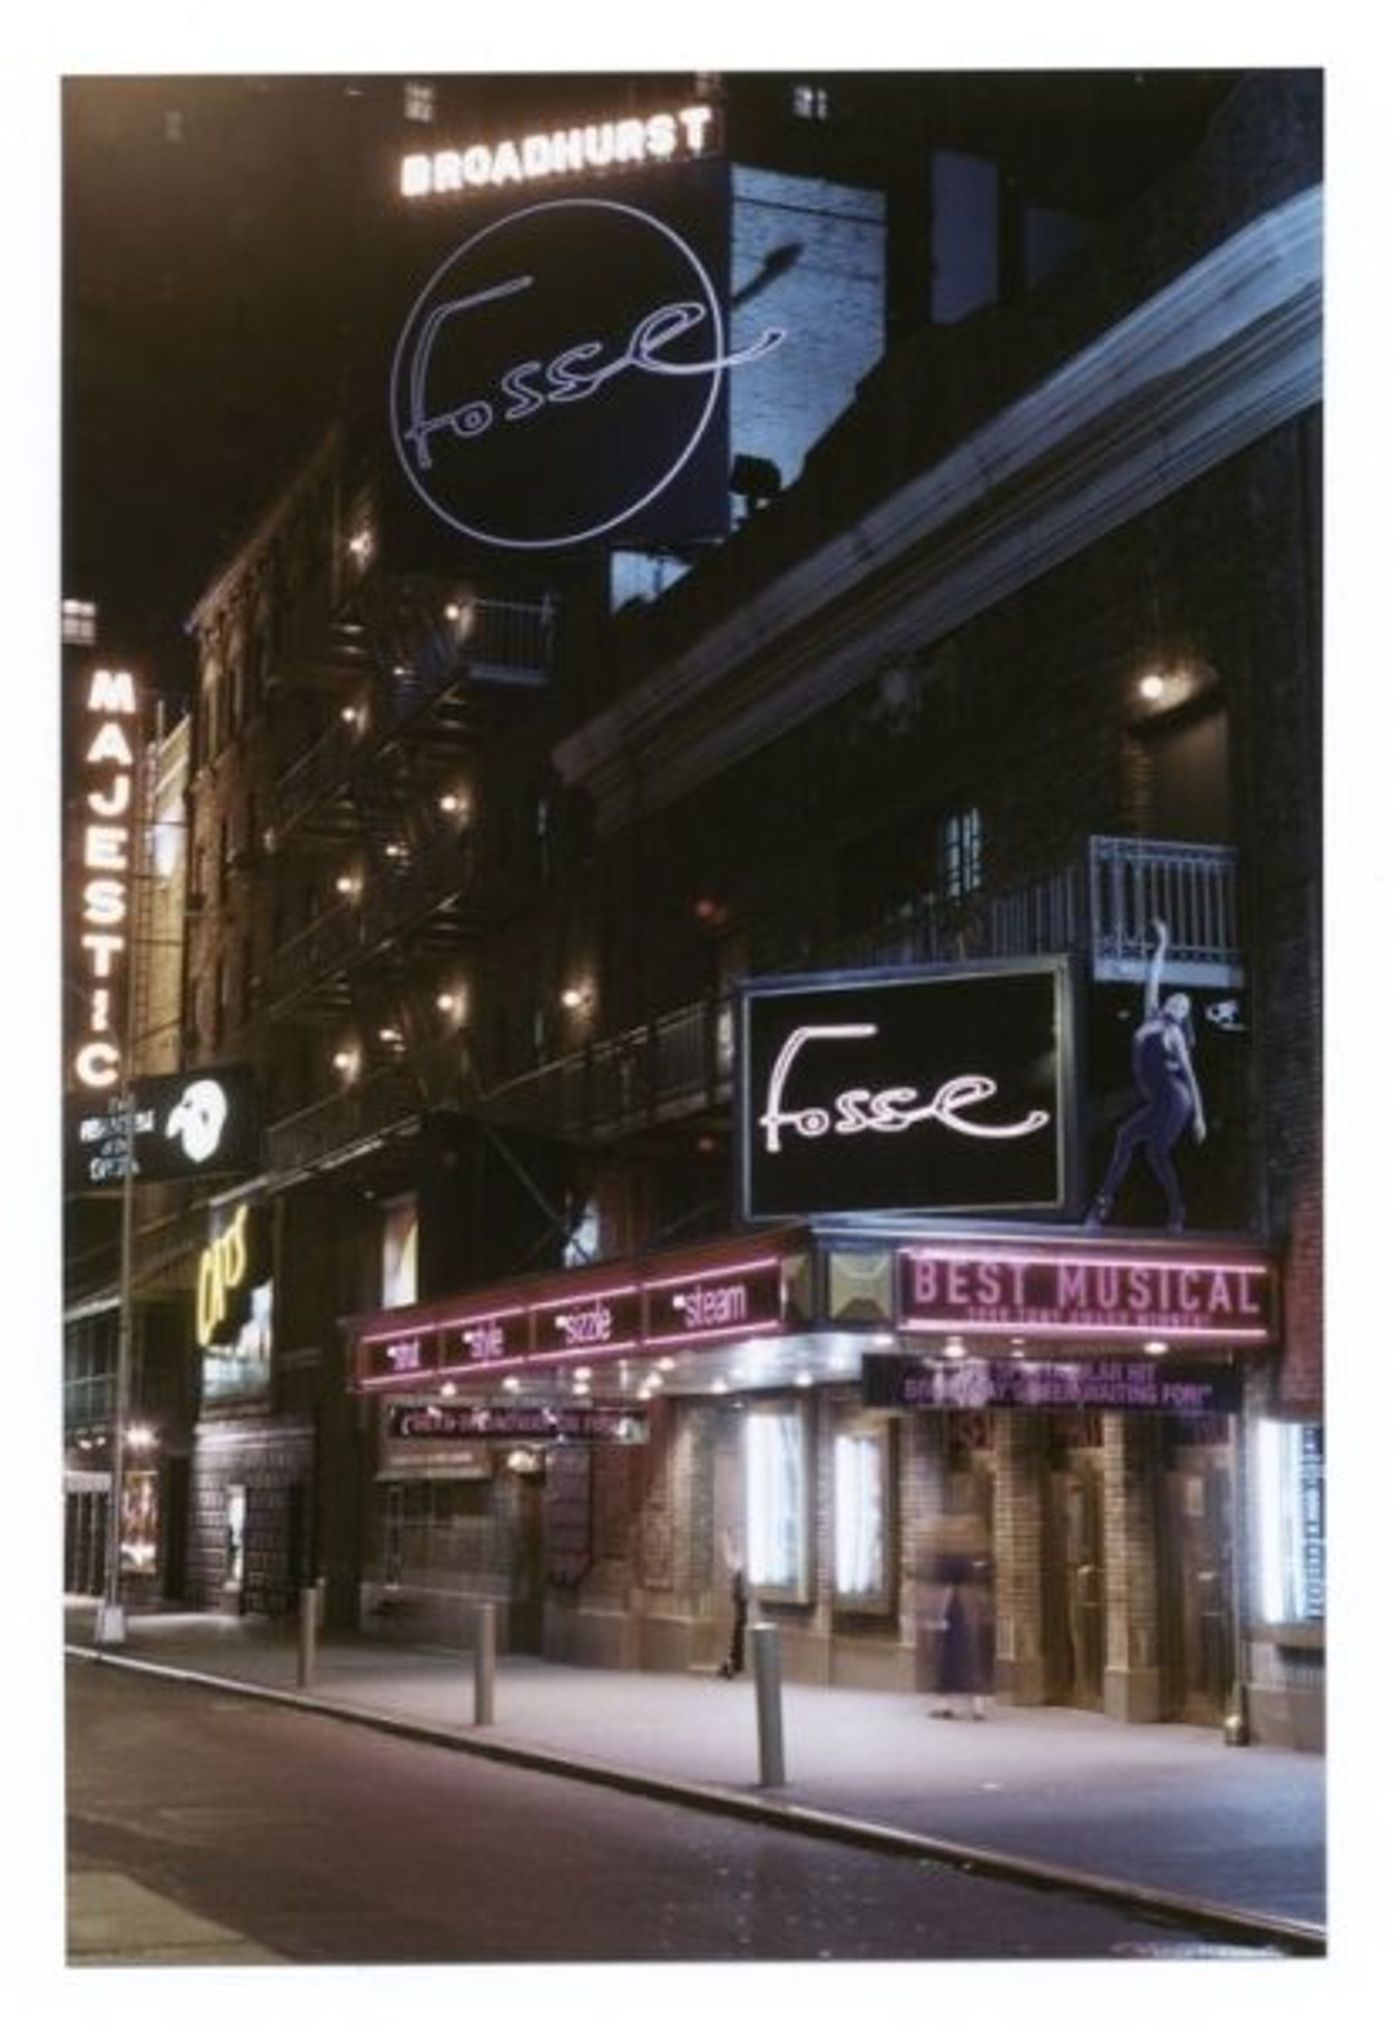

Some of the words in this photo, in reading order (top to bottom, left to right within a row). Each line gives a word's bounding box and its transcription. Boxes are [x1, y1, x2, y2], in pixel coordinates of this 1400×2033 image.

[400, 105, 712, 198] BROADHURST
[404, 274, 787, 469] Fosse
[75, 669, 137, 1087] MAJESTIC
[759, 1022, 1051, 1153] Fosse
[684, 1284, 747, 1328] steam
[914, 1259, 1029, 1305] BEST
[1057, 1264, 1261, 1314] MUSICAL
